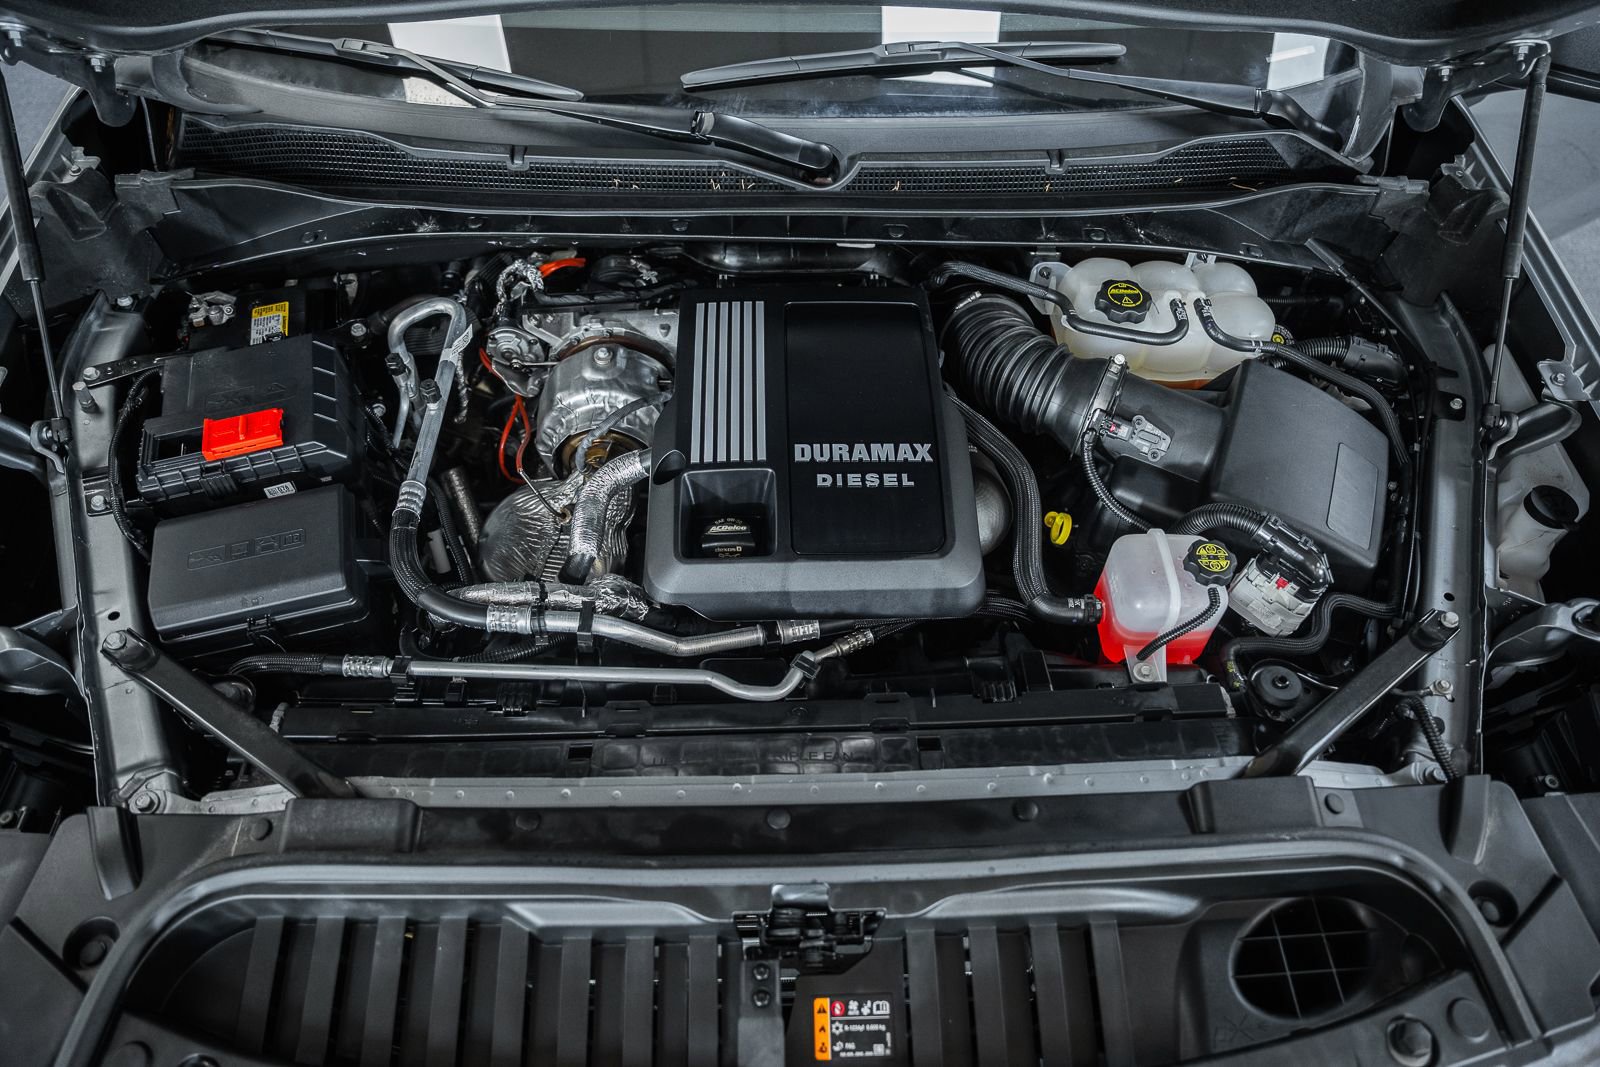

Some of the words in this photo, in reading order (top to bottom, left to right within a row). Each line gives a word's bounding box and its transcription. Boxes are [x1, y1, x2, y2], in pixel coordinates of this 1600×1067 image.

[793, 442, 934, 463] DURAMAX
[815, 472, 915, 488] DIESEL
[708, 525, 748, 535] ACDelco
